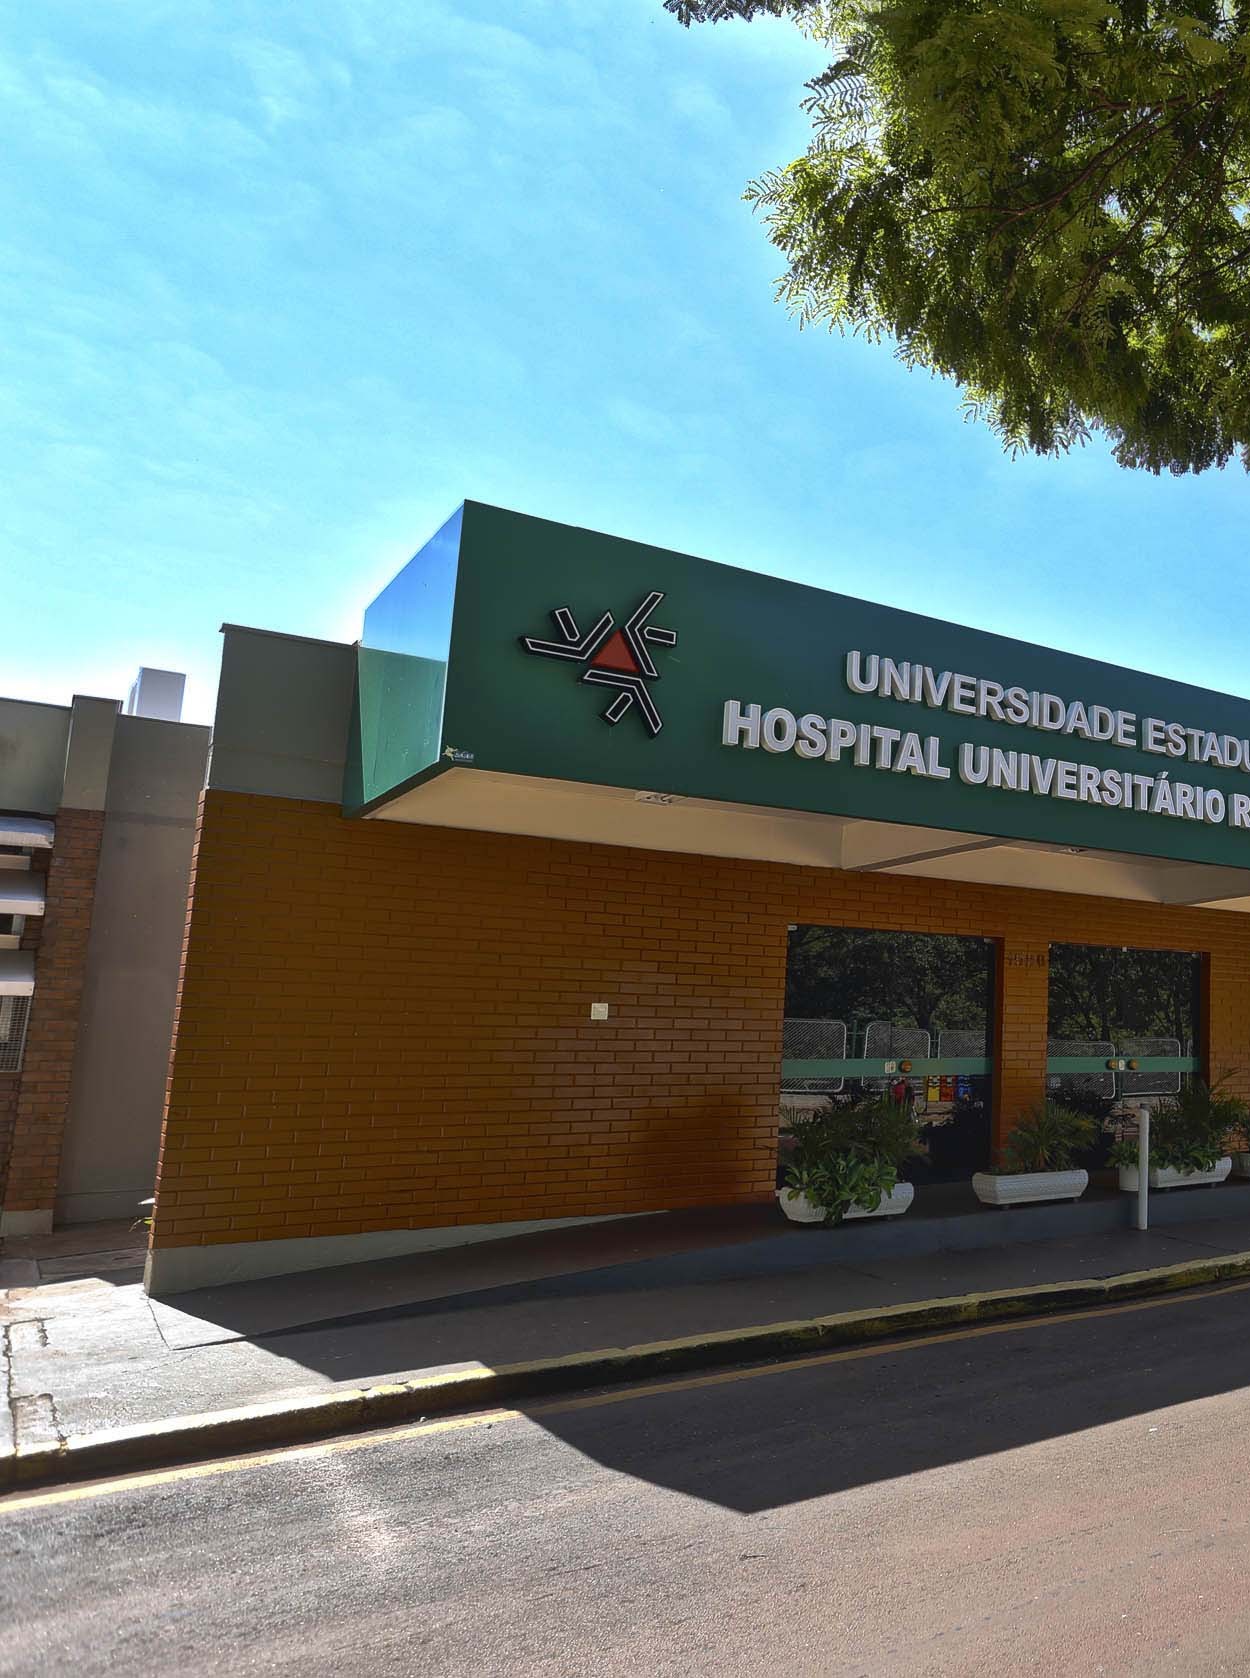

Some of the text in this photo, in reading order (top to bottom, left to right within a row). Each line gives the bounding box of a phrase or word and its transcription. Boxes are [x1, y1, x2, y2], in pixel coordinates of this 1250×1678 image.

[846, 650, 1137, 747] UNIVERSIDADE
[722, 699, 951, 779] HOSPITAL
[959, 743, 1226, 823] UNIVERSITÁRIO
